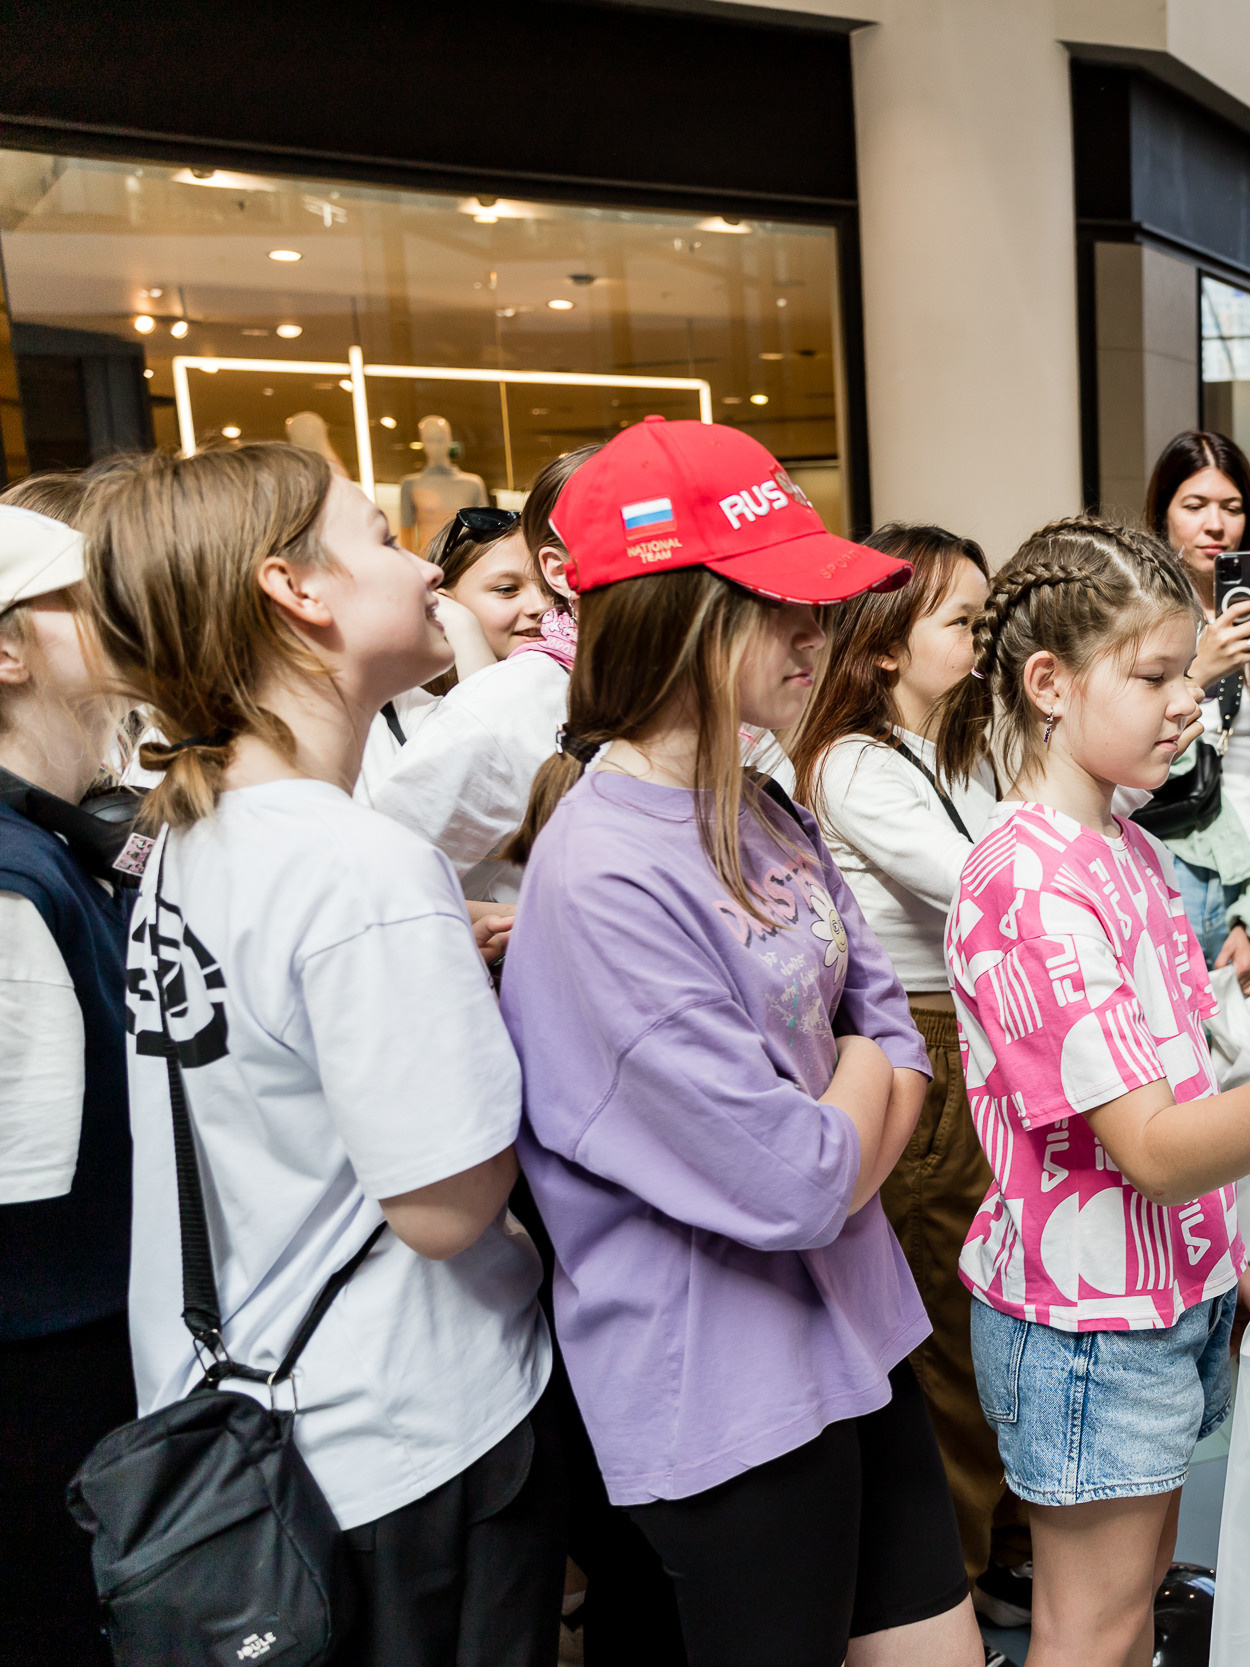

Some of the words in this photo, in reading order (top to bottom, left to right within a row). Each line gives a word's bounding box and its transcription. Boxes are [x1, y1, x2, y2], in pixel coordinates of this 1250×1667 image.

[626, 538, 683, 557] NATIONAL
[640, 549, 672, 564] TEAM
[1088, 857, 1133, 941] FILA
[1178, 1198, 1211, 1266] ILA
